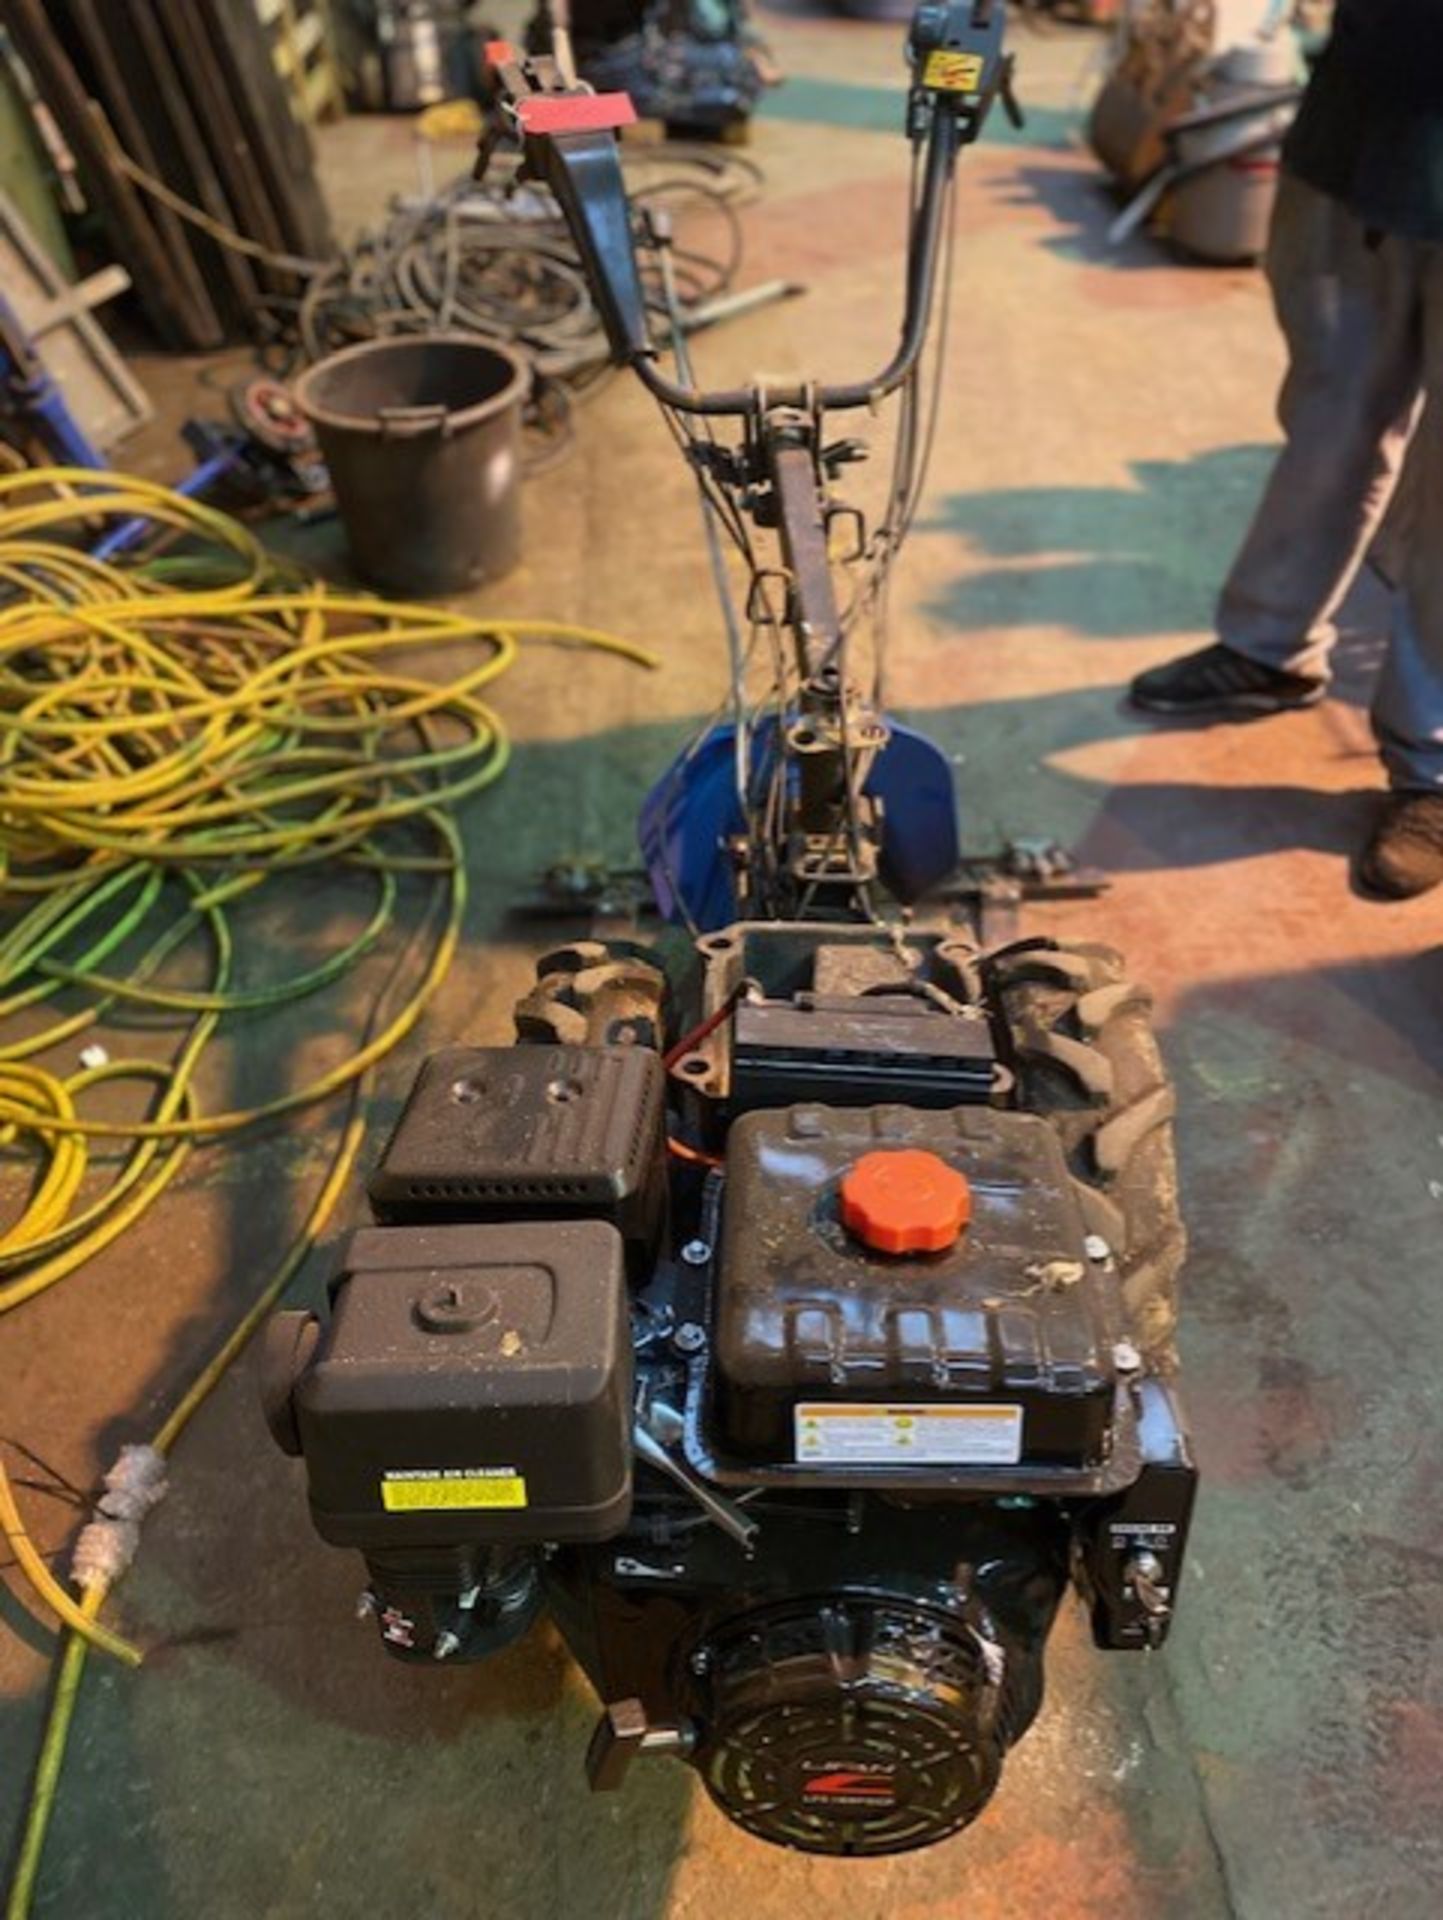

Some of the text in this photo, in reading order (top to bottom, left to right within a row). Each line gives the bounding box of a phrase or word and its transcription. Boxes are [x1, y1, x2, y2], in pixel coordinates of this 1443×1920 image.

[384, 1466, 517, 1480] MAINTAIN AIR CLEANER
